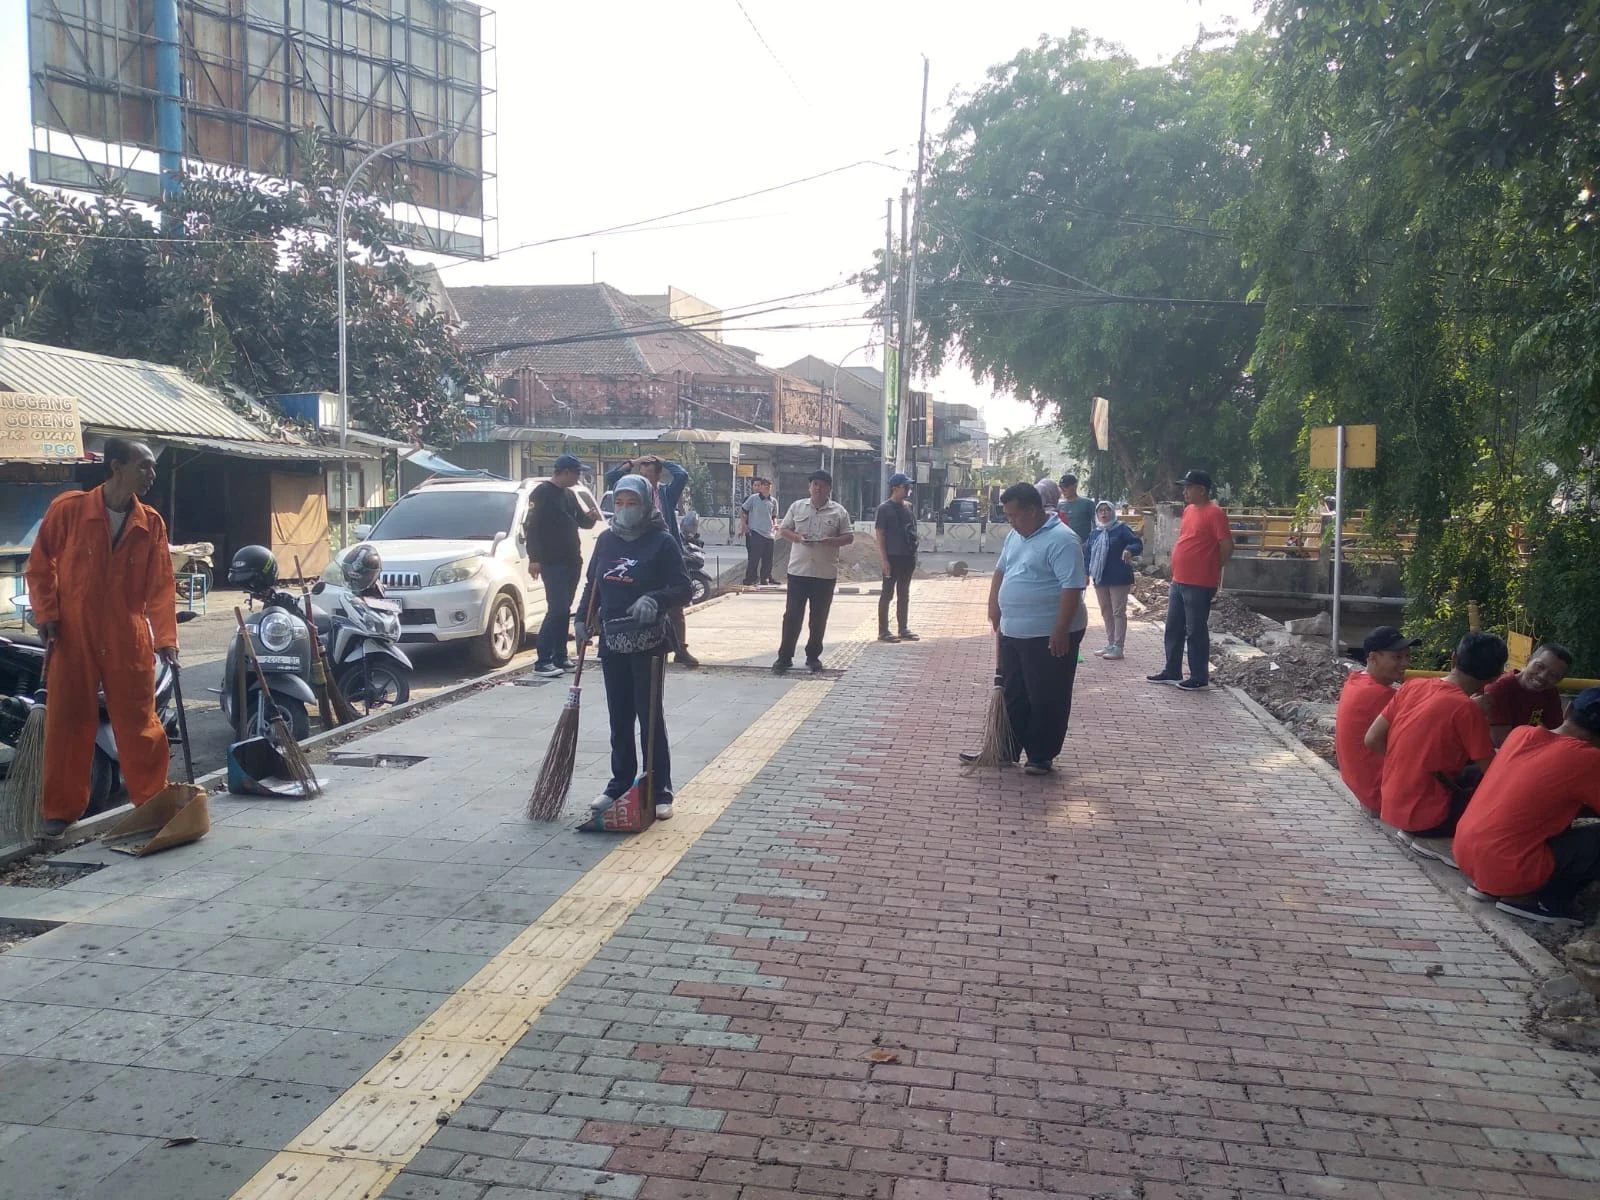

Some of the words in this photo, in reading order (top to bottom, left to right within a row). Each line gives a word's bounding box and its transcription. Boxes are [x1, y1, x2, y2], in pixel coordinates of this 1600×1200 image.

[0, 394, 73, 411] NGGANG
[6, 412, 75, 429] GORENG
[31, 431, 76, 441] OVAN
